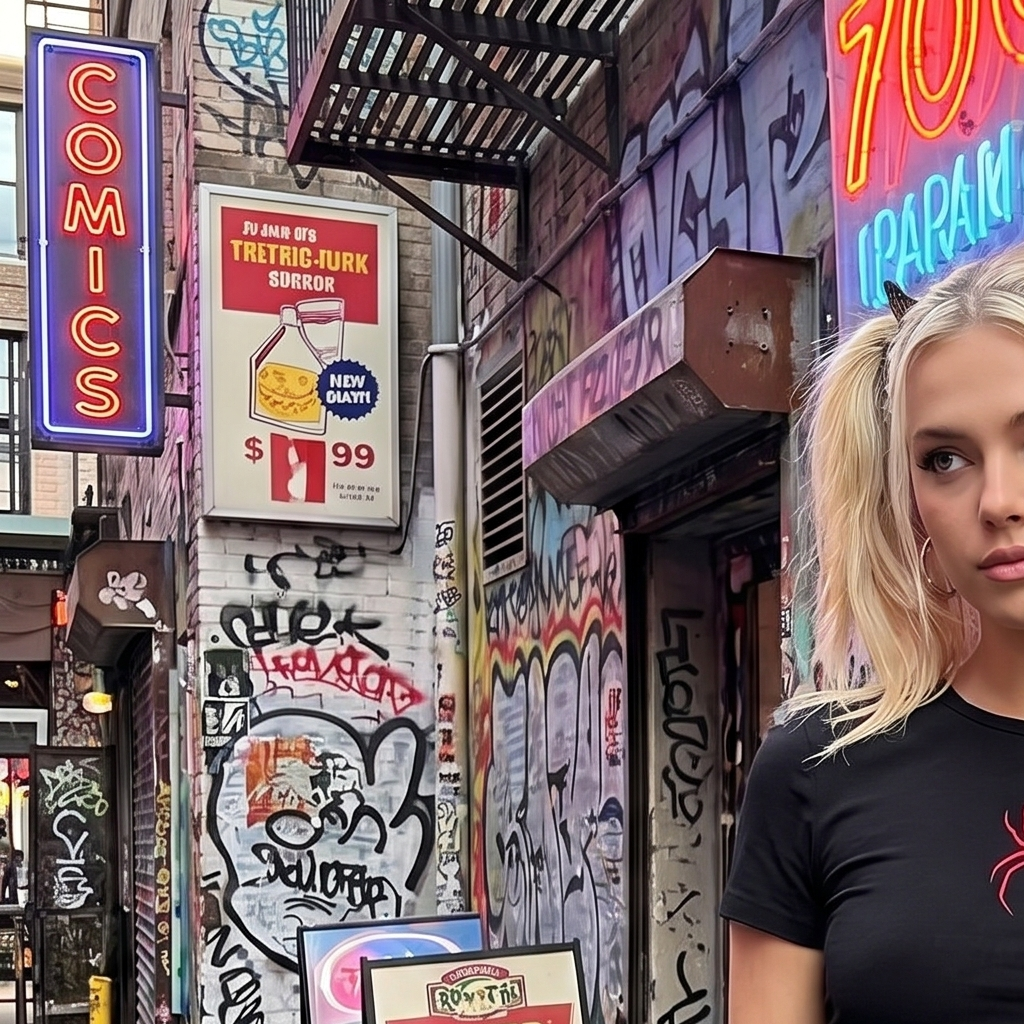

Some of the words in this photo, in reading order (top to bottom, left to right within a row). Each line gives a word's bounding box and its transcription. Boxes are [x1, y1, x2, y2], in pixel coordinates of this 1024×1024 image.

[63, 62, 127, 418] COMICS
[329, 373, 366, 389] NEW
[331, 441, 376, 470] 99
